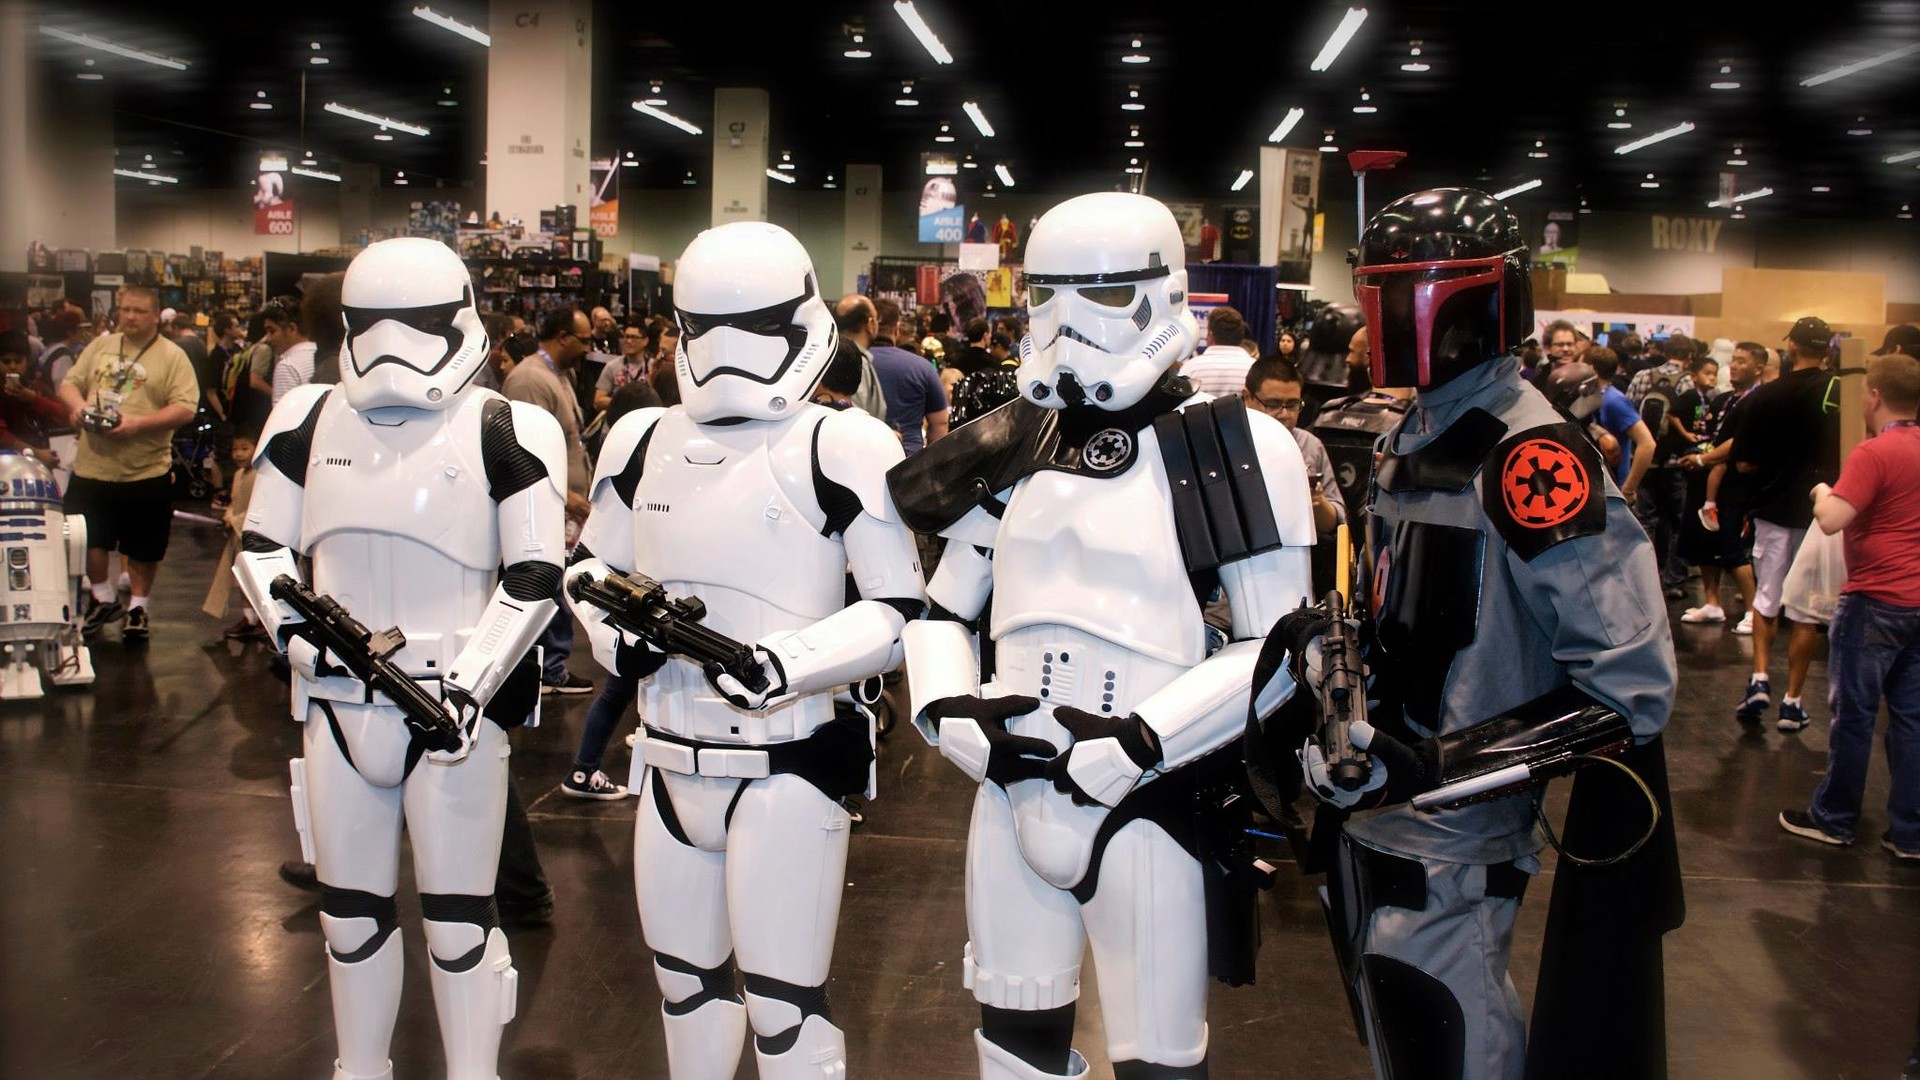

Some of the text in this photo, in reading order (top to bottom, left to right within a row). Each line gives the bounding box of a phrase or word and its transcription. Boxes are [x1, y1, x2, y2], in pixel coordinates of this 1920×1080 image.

[267, 210, 293, 220] AISLE
[268, 220, 293, 234] 600
[1651, 214, 1723, 253] ROXY
[935, 228, 962, 241] 400
